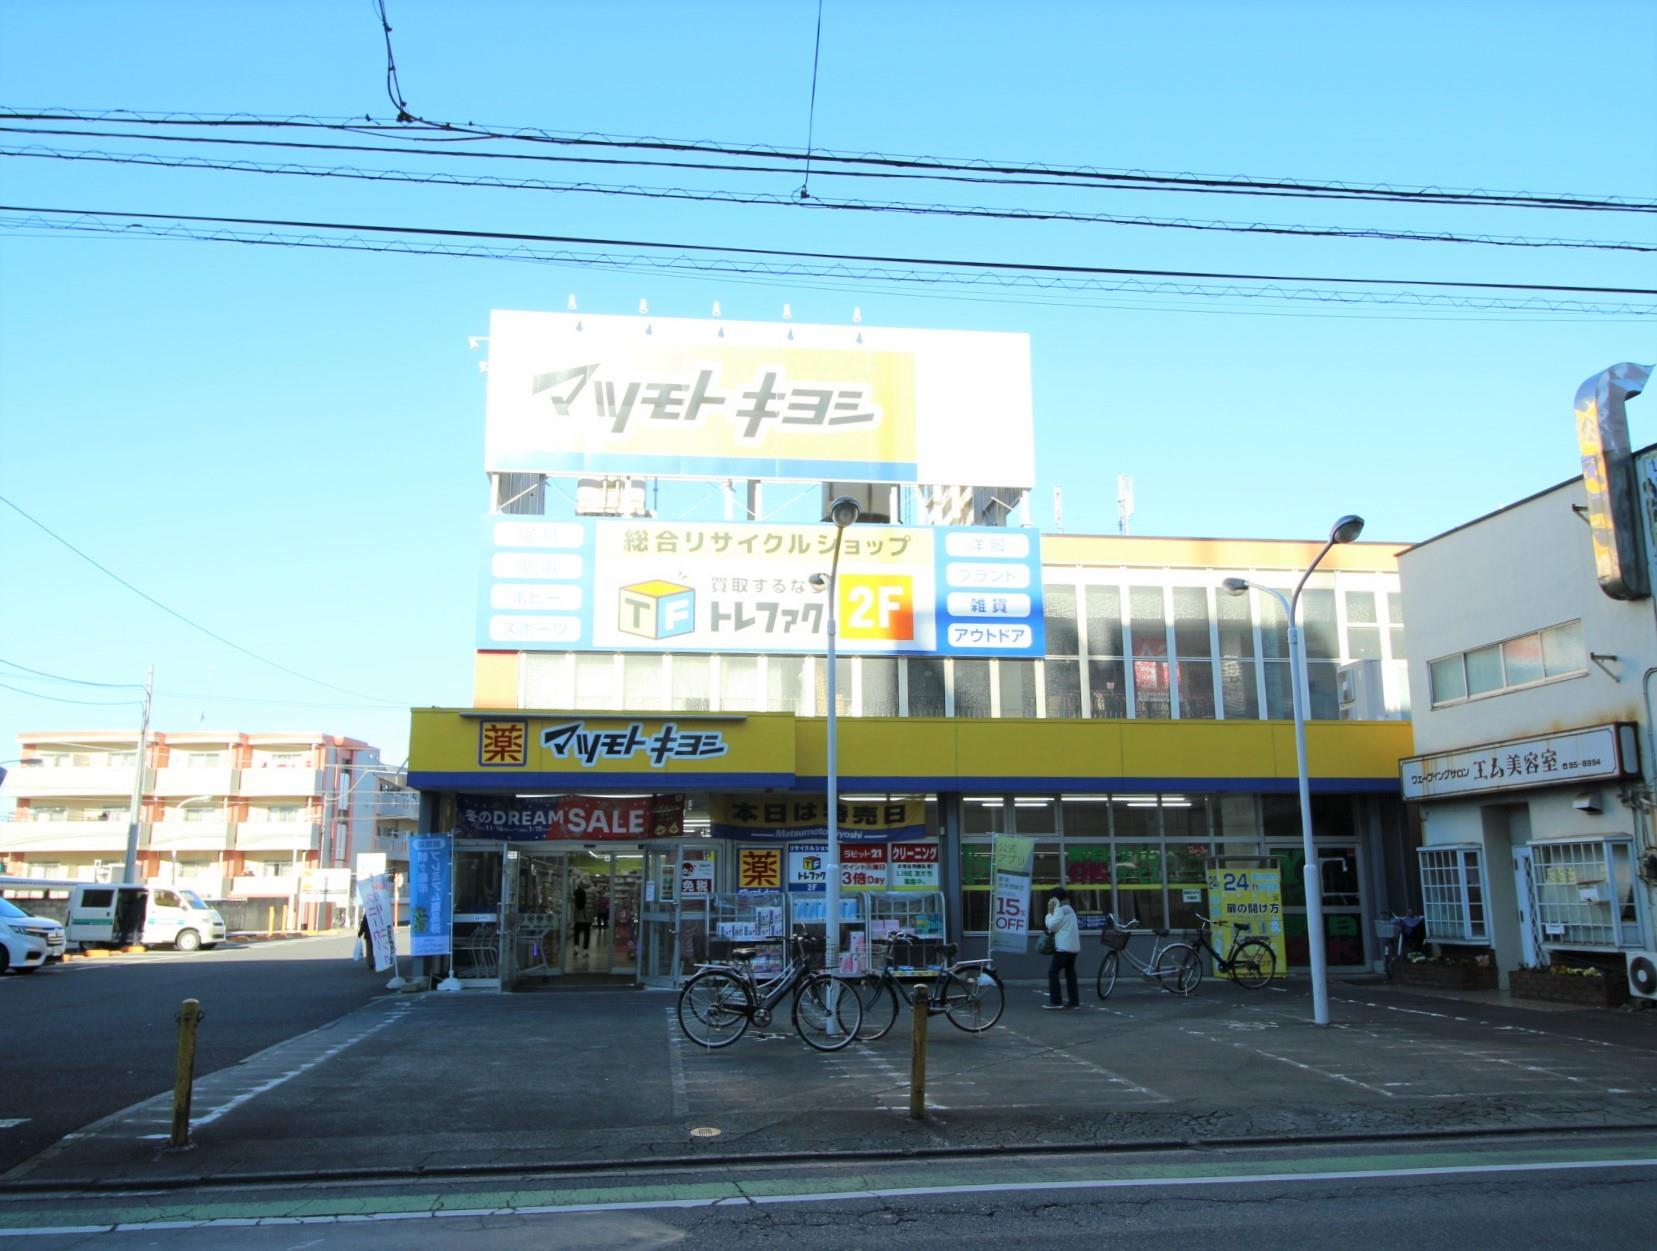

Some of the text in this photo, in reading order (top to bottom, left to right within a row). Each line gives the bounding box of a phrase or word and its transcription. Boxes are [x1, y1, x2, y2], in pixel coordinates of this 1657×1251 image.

[533, 363, 874, 437] マツモトキヨシ
[624, 529, 911, 556] 総合リサイクルショップ
[711, 576, 825, 594] 買取するな
[711, 600, 824, 634] トレファク
[849, 584, 904, 630] 2F
[970, 597, 1008, 614] 雑貨
[954, 628, 1025, 643] アウトドア
[484, 724, 522, 762] 薬
[544, 722, 725, 764] マツモトキヨシ
[567, 807, 644, 834] SALE
[893, 846, 937, 860] クリーニング
[743, 851, 777, 886] 薬
[995, 916, 1025, 931] OFF
